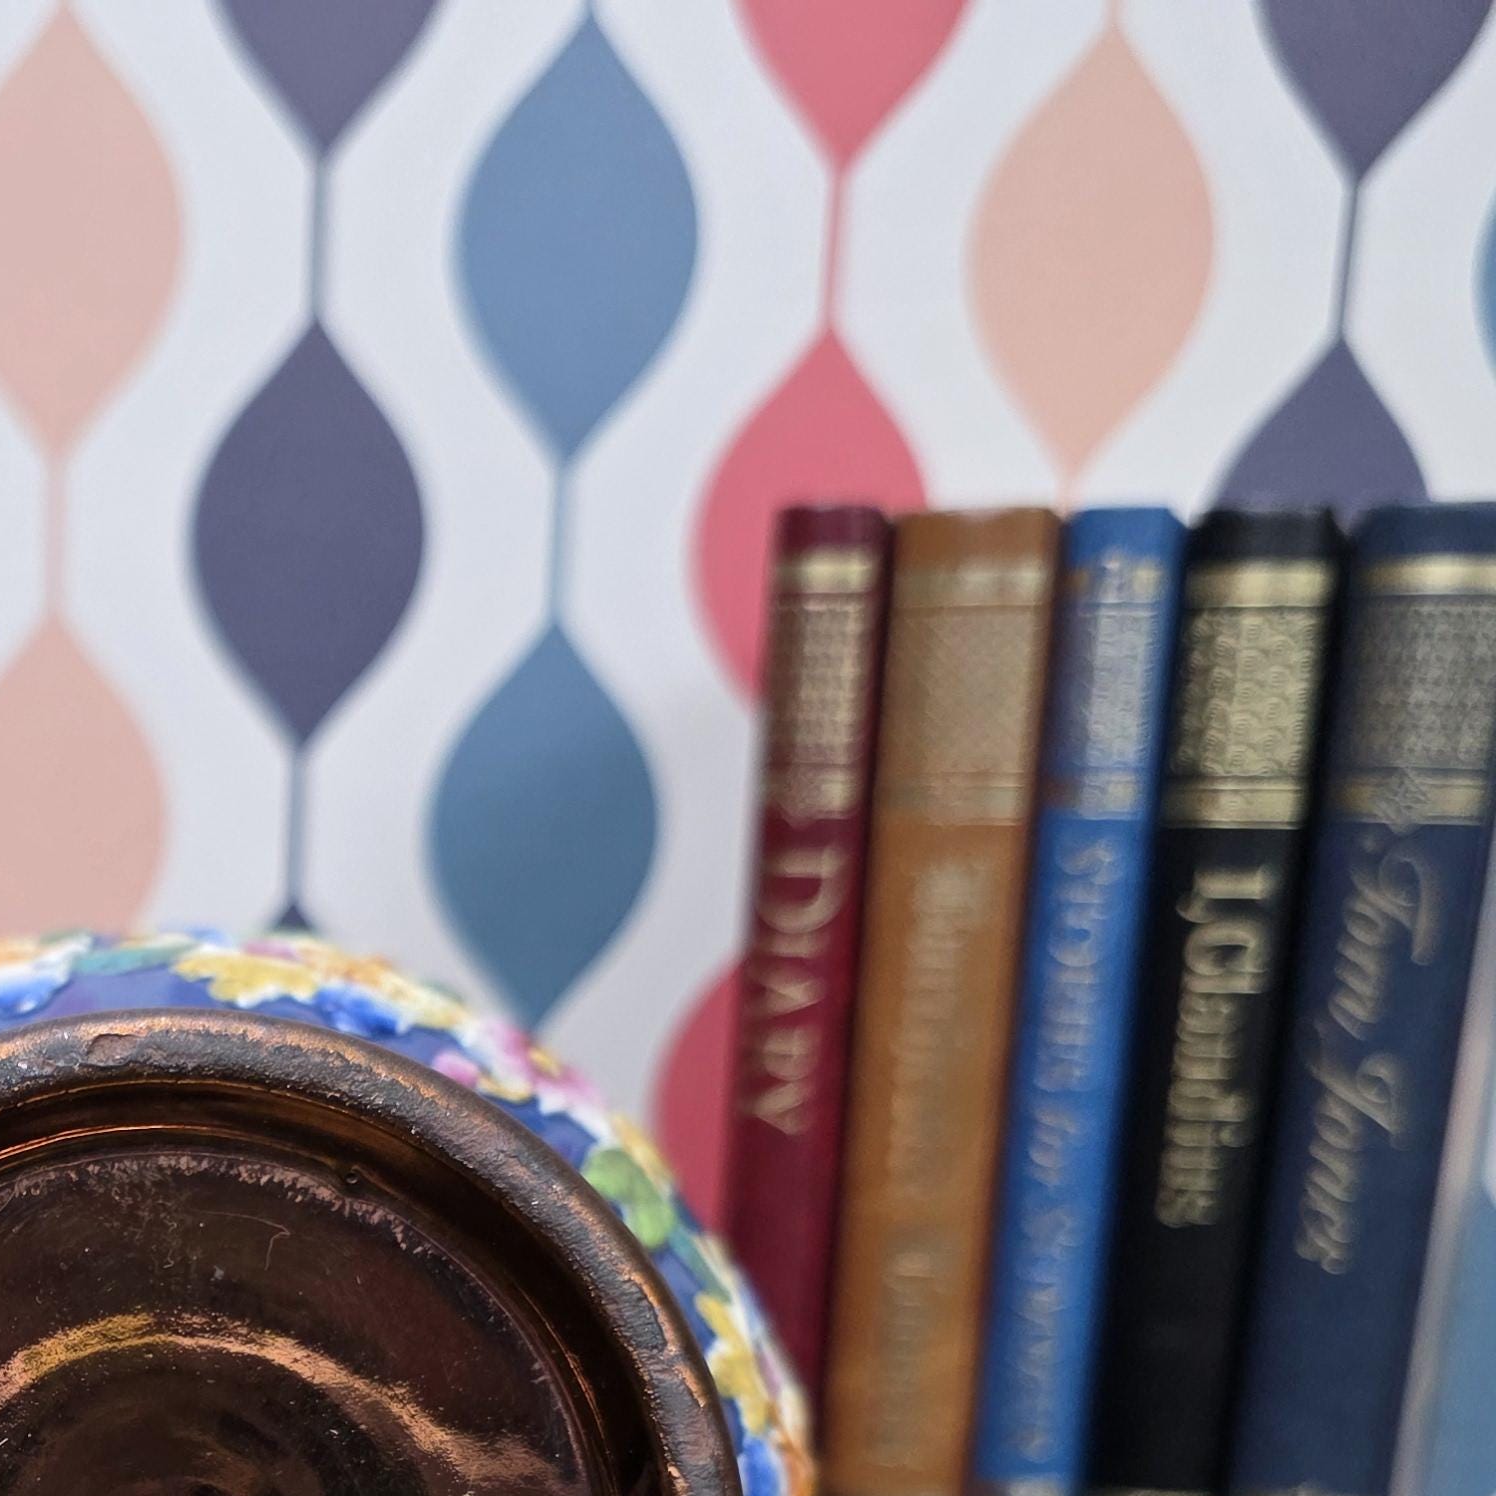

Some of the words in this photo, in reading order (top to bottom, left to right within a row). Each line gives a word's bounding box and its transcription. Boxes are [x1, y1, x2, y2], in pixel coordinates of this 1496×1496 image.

[740, 842, 844, 1136] DIARY
[1328, 836, 1442, 1042] Tom
[1295, 1018, 1408, 1275] Jones
